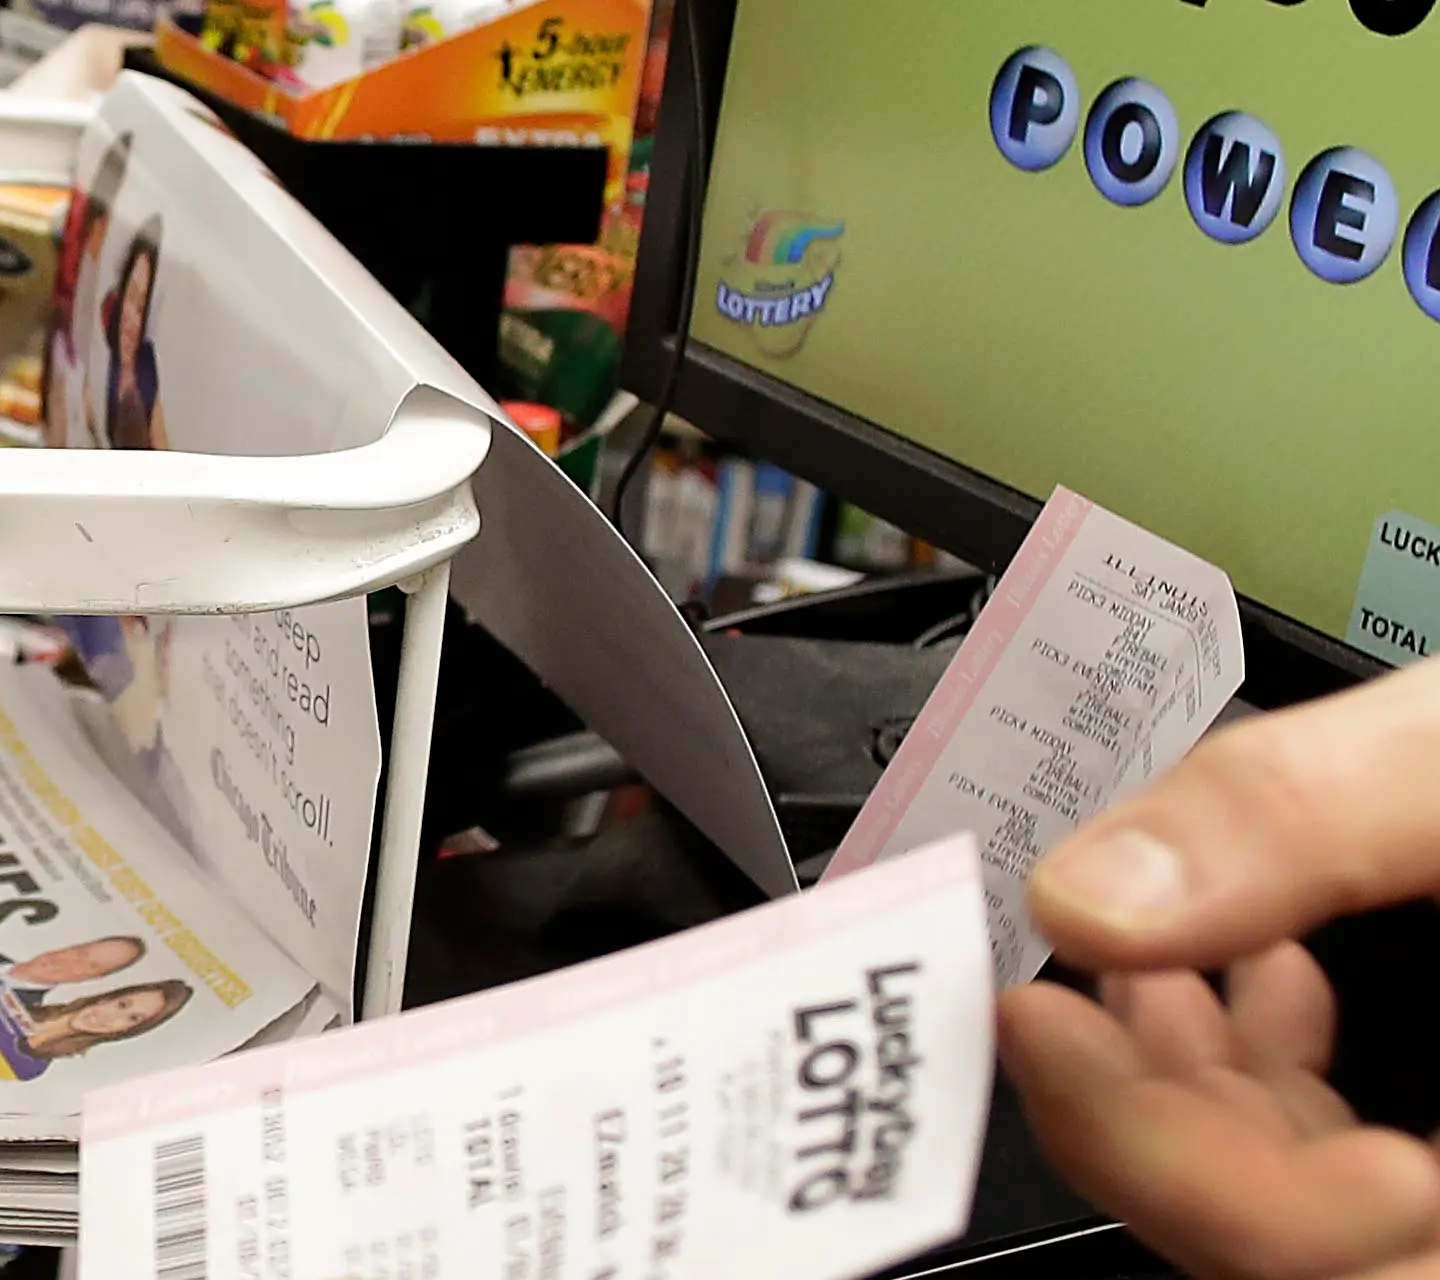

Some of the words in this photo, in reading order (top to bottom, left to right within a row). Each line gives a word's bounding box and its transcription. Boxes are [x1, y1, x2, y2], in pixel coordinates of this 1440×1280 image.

[716, 271, 834, 327] LOTTERY
[1361, 608, 1430, 658] TOTAL
[282, 664, 331, 727] read
[787, 999, 860, 1212] LOTTO
